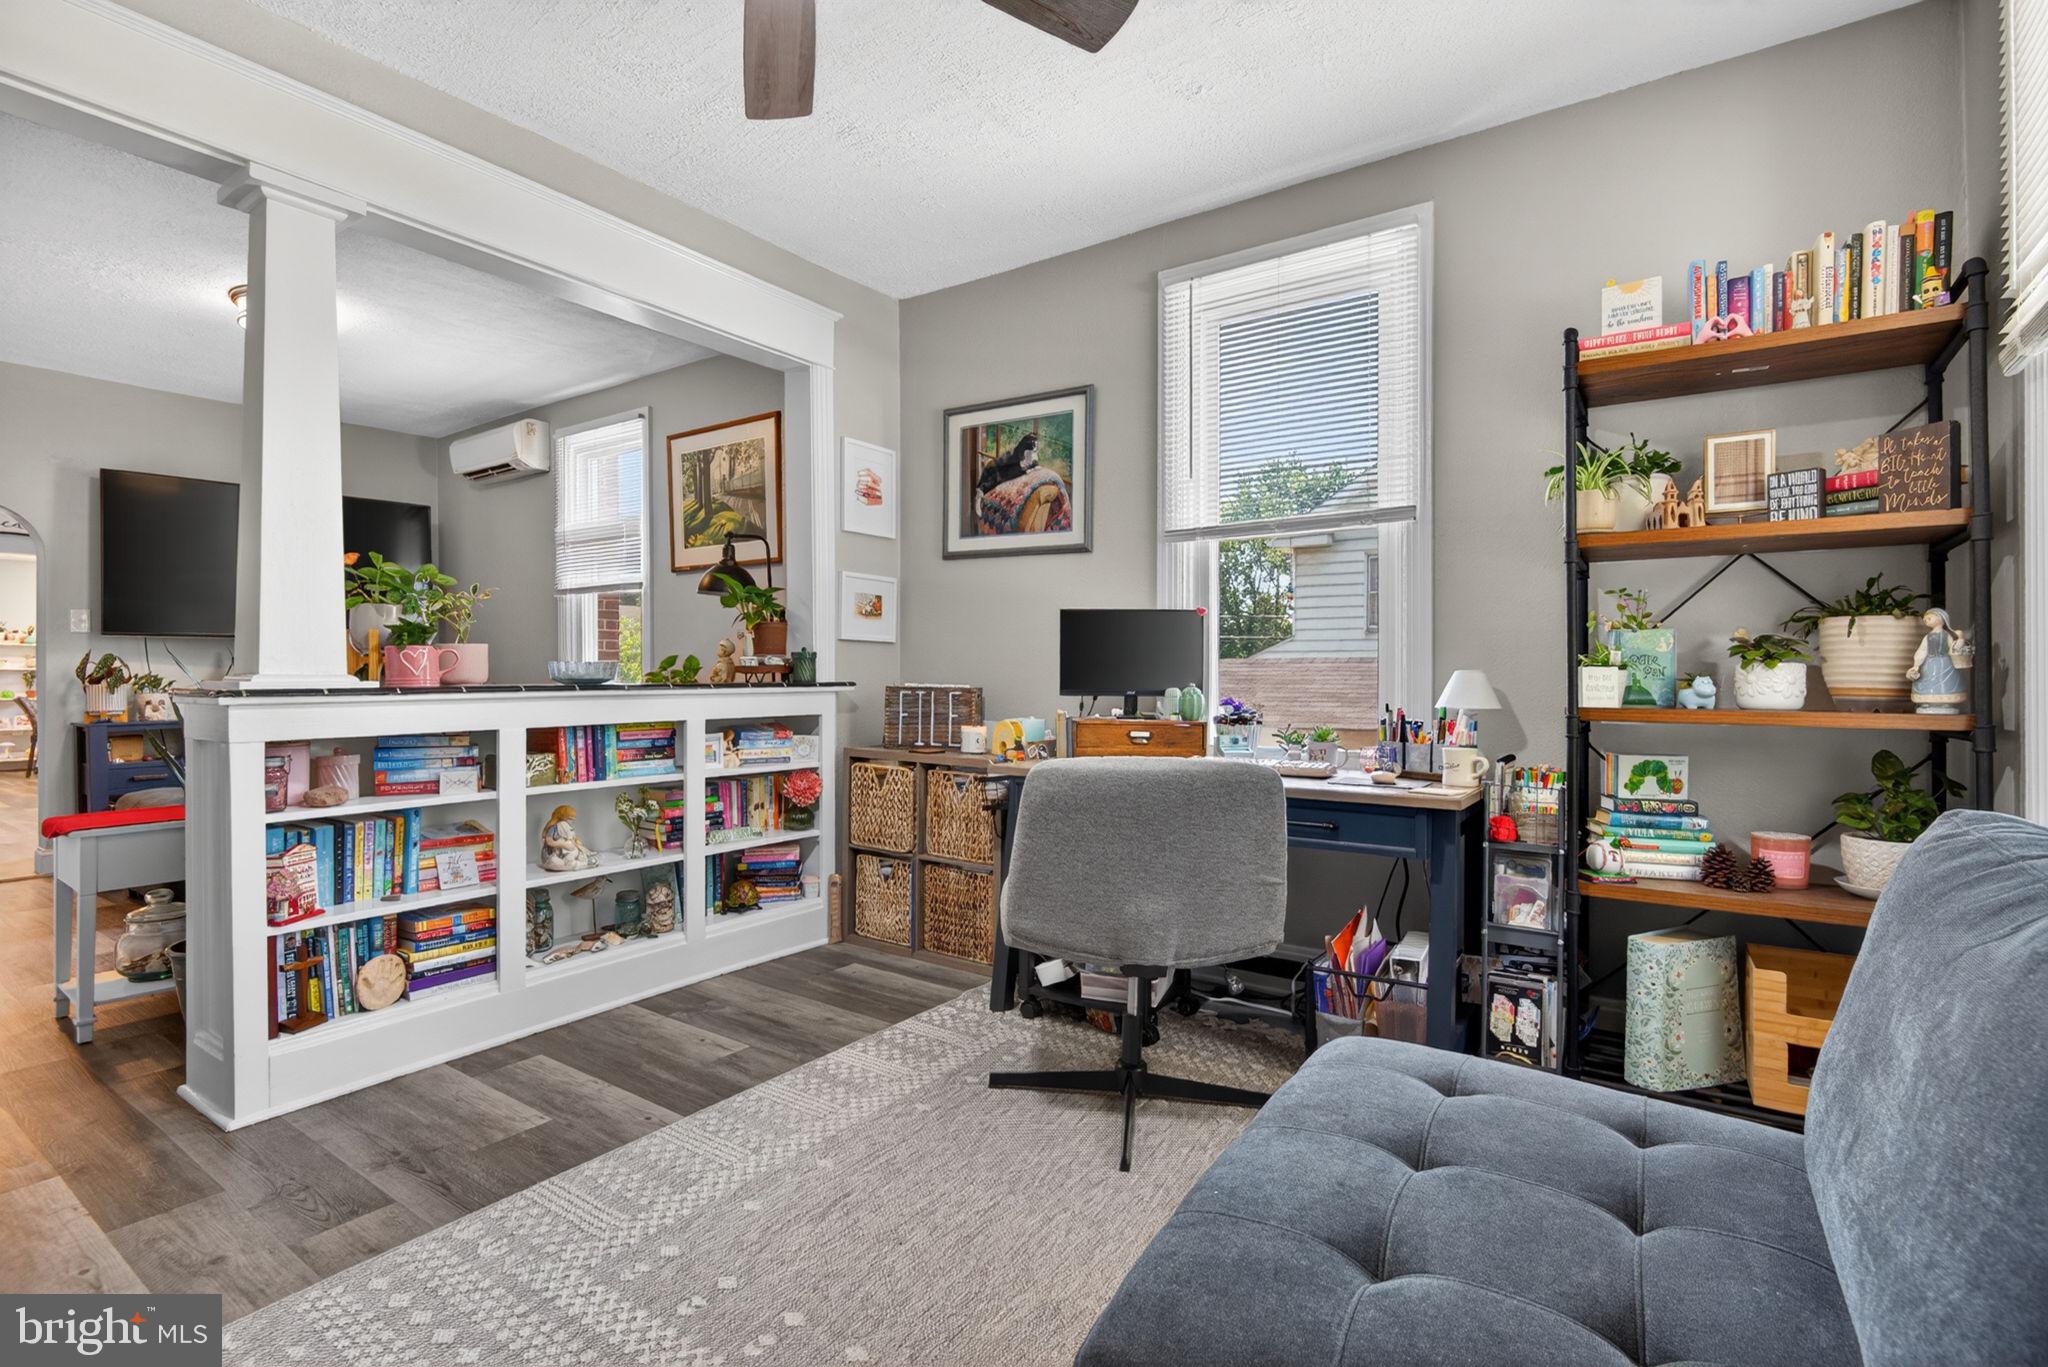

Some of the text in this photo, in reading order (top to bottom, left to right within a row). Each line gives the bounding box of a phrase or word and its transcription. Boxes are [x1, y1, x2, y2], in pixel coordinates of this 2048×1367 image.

[1880, 454, 1905, 475] BIG
[1788, 469, 1817, 486] WORLD
[1769, 511, 1787, 522] BE
[1787, 506, 1818, 521] KIND
[899, 690, 962, 748] FILE
